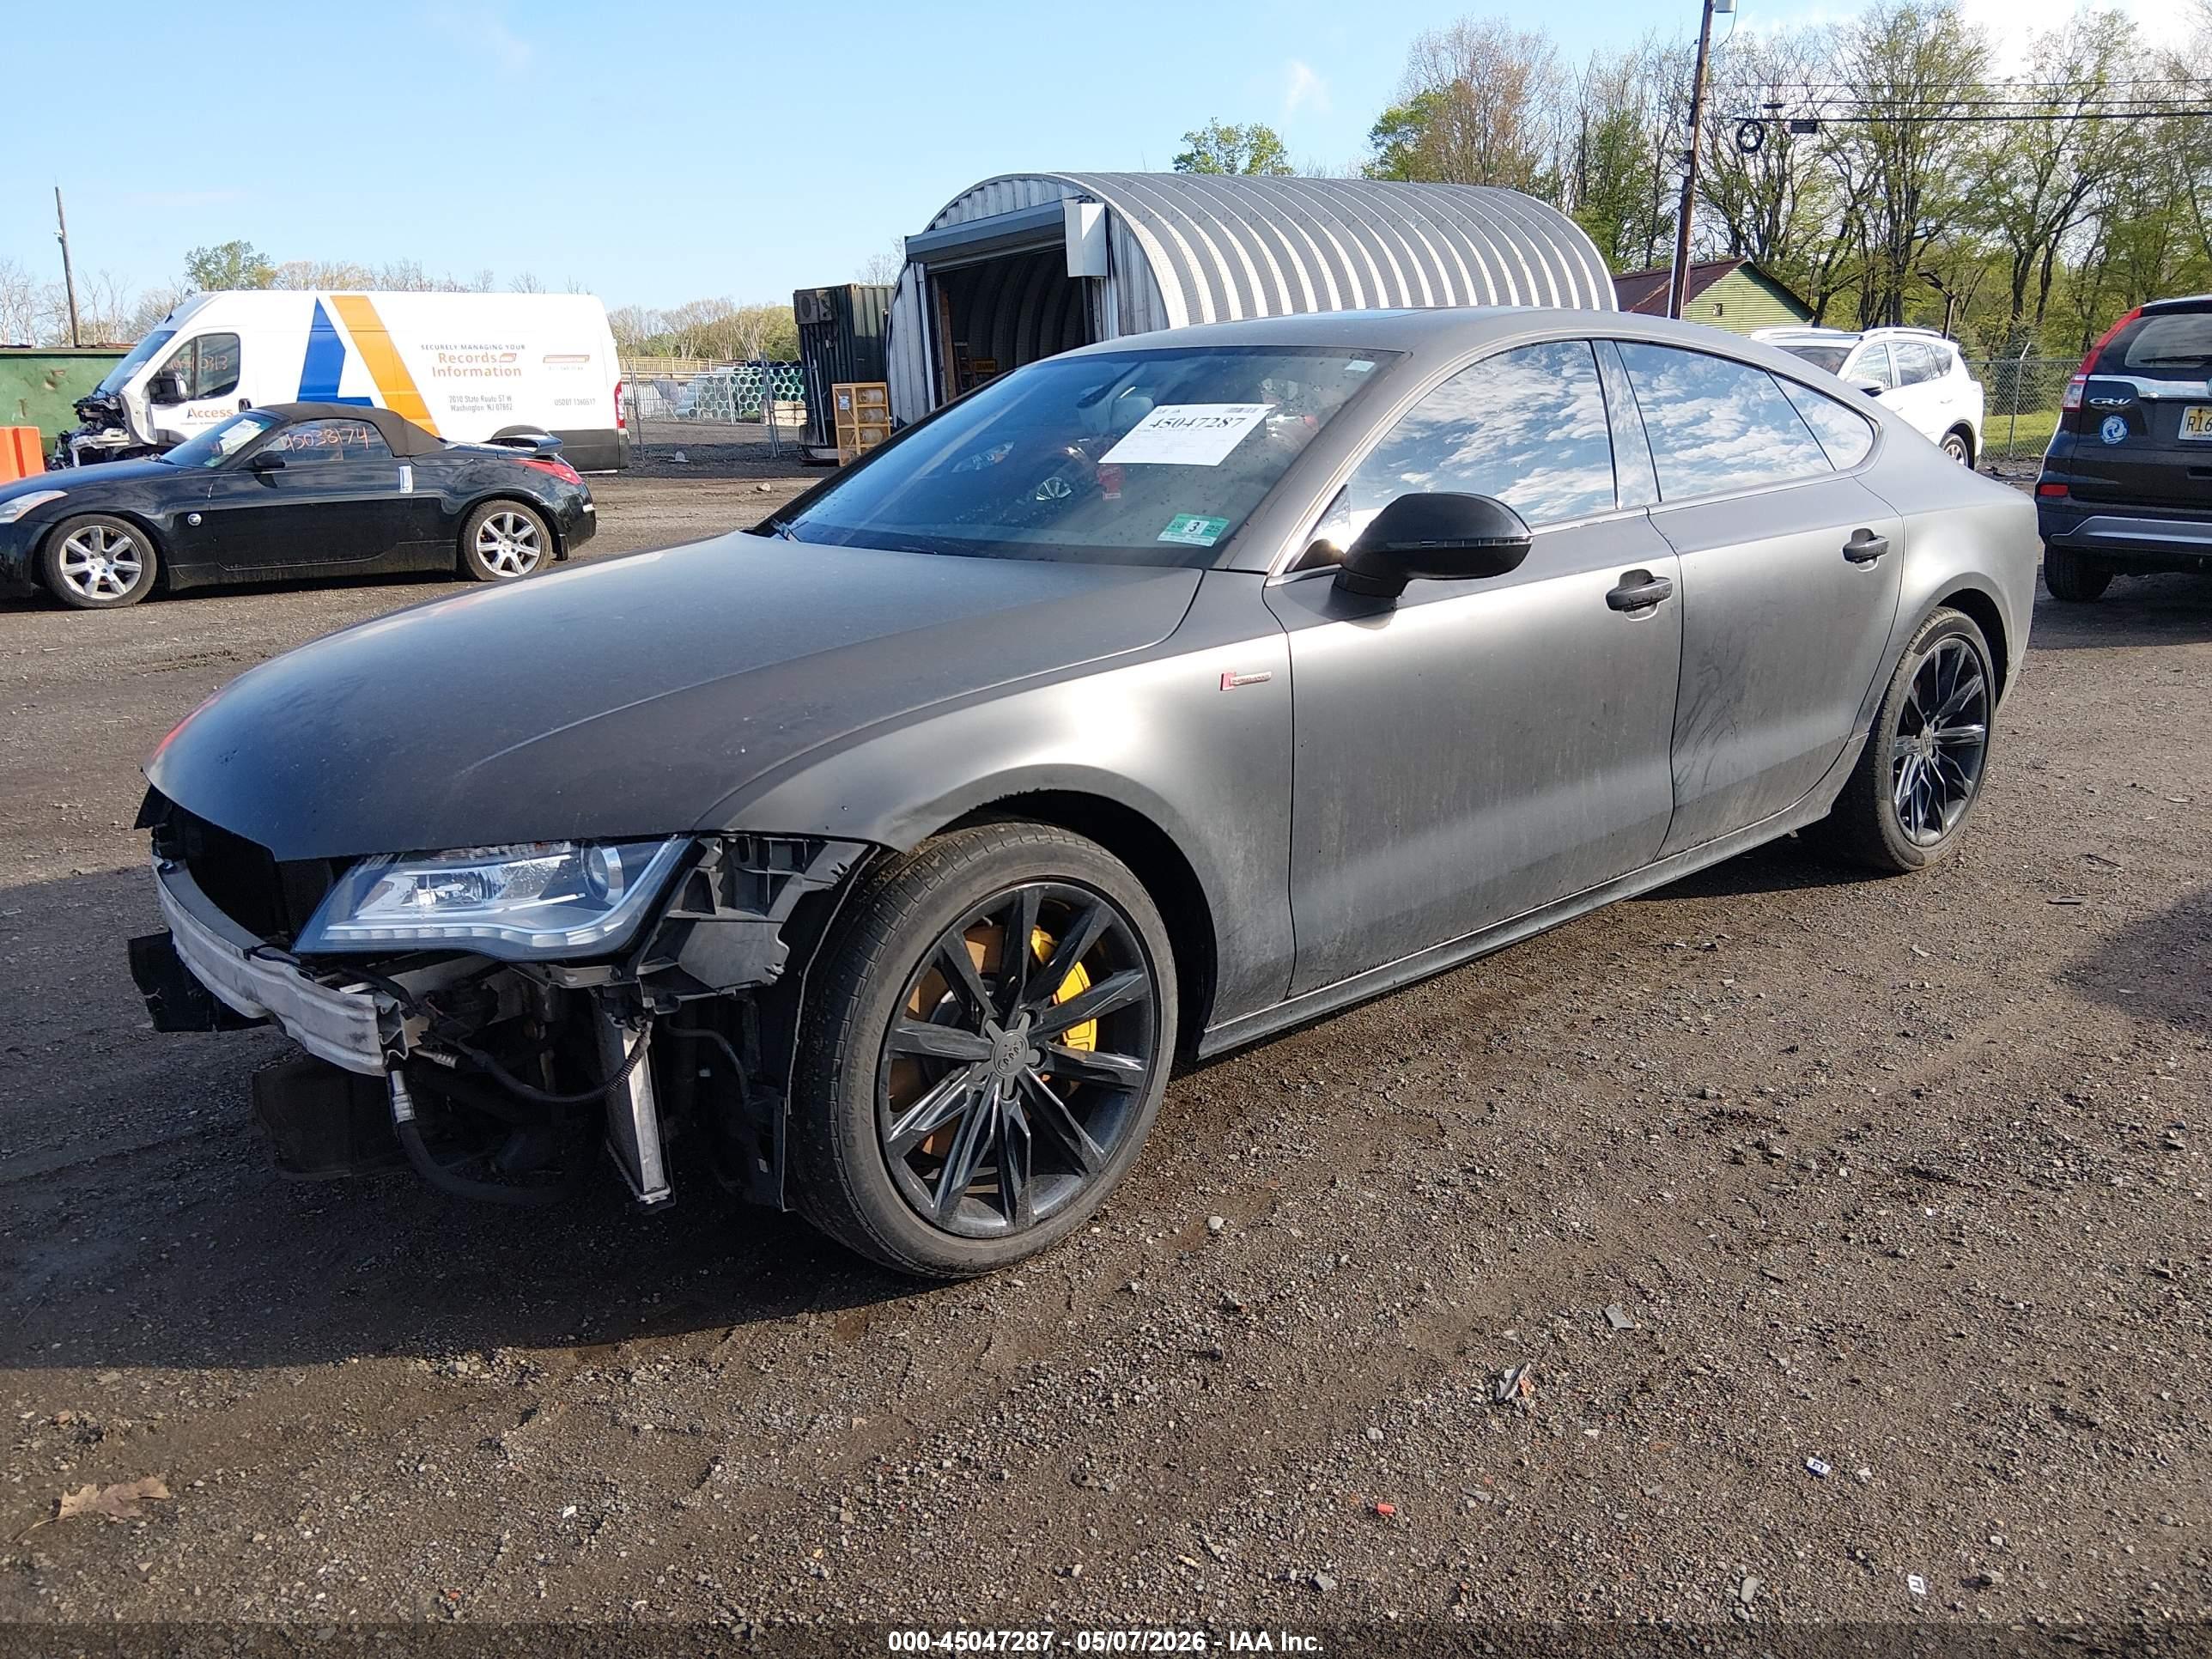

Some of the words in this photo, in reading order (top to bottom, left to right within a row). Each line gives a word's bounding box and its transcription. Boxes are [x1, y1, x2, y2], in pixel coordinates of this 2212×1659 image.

[438, 352, 497, 363] Records
[432, 366, 522, 377] Information
[187, 408, 234, 419] Access
[1149, 417, 1248, 428] 45047287
[281, 426, 369, 453] 45038174
[1188, 521, 1200, 532] 3
